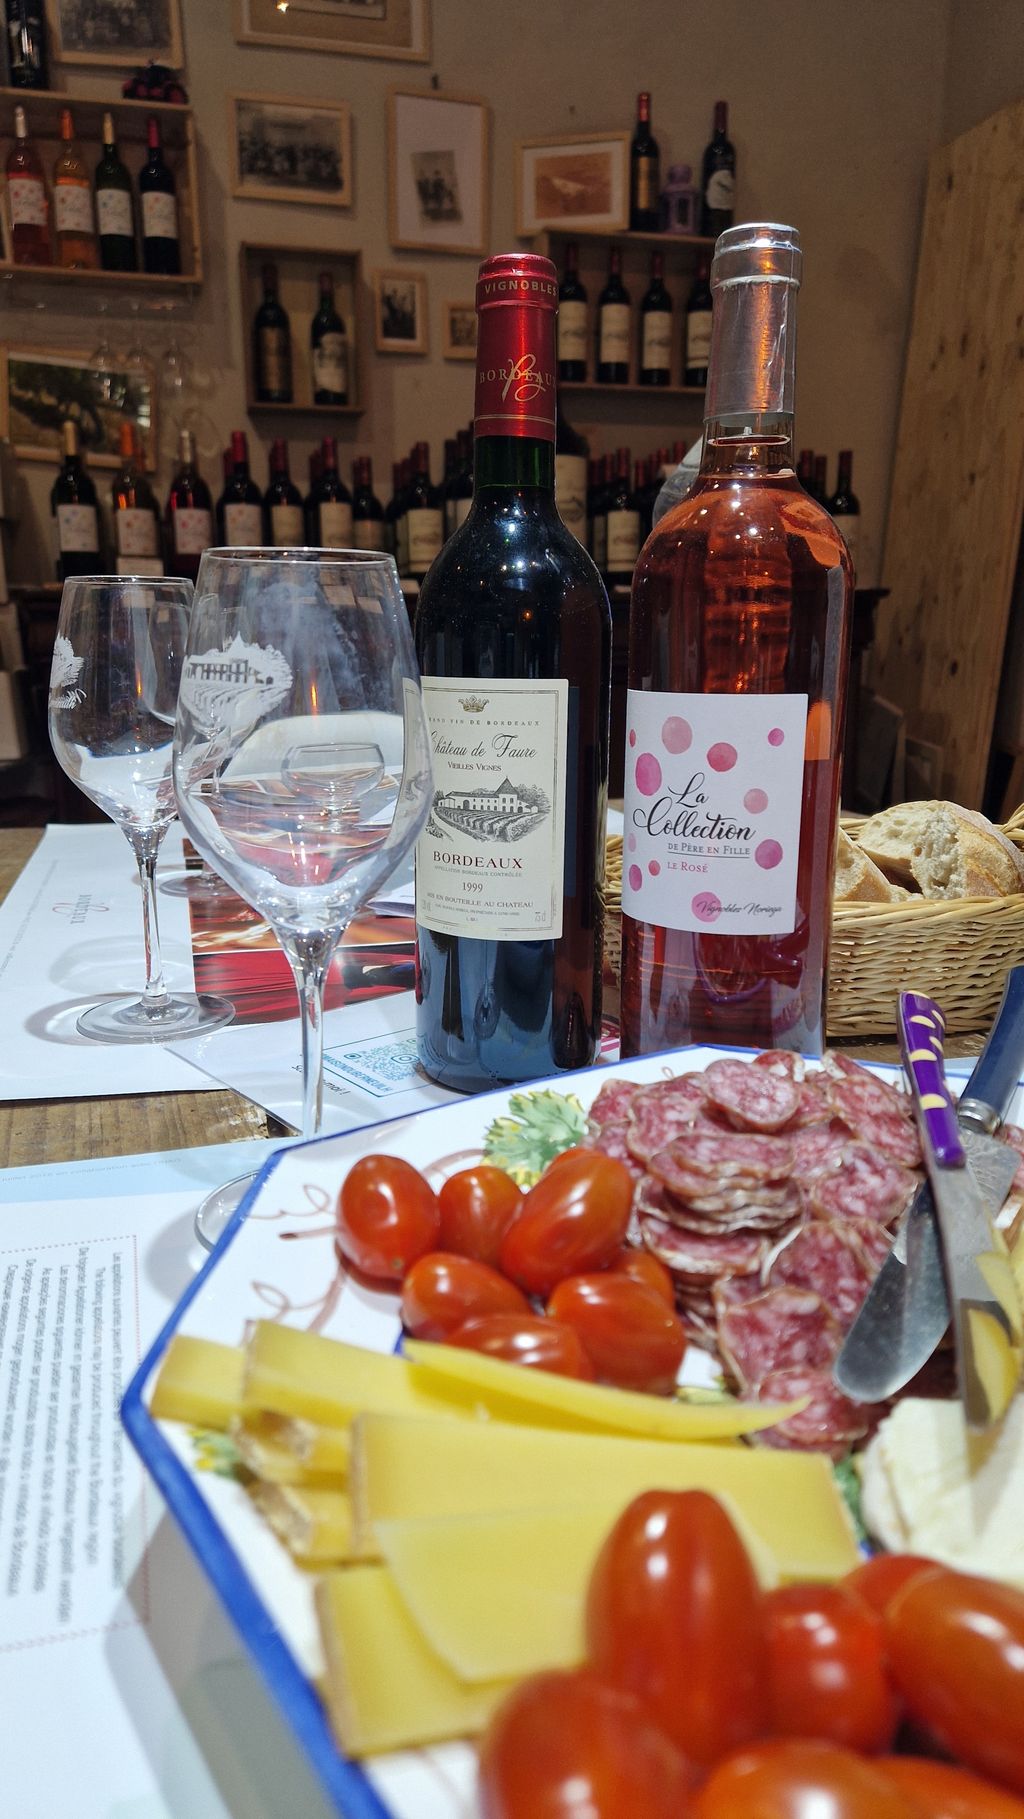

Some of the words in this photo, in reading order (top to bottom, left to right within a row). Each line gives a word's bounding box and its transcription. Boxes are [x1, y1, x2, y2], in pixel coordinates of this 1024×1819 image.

[484, 280, 557, 297] VIGNOBLES
[471, 741, 486, 757] de
[492, 733, 537, 758] Faure
[476, 763, 502, 772] VIGNES
[668, 772, 710, 808] La
[633, 796, 757, 841] Collection
[668, 843, 679, 851] DE
[681, 842, 704, 854] PÈRE
[707, 846, 720, 854] EN
[723, 845, 751, 855] FILLE
[433, 850, 523, 869] BORDEAUX
[667, 862, 678, 870] LE
[681, 862, 709, 873] ROSÉ
[462, 882, 484, 893] 1999
[445, 896, 482, 906] BOUTEILLE
[696, 900, 742, 916] Vignobles
